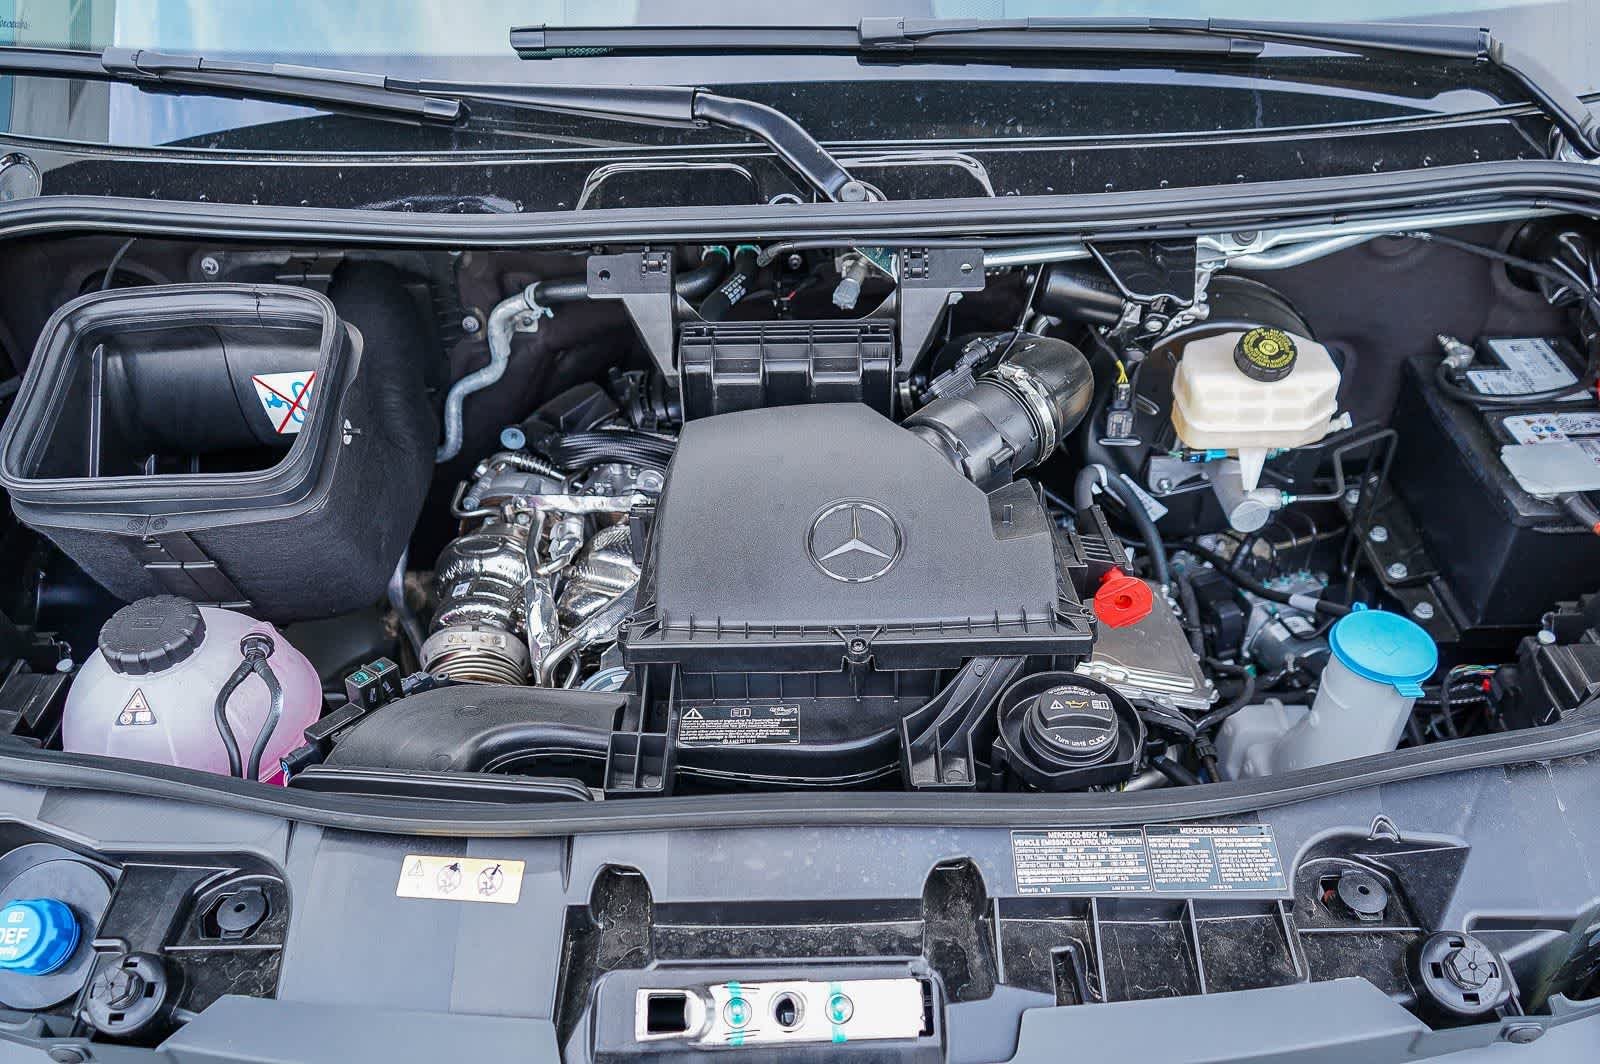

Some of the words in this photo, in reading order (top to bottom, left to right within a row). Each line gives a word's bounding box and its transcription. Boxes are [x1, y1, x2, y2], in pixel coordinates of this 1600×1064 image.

[1055, 734, 1070, 745] Turn
[1088, 734, 1107, 746] CLICK
[1101, 837, 1142, 845] INFORMATION
